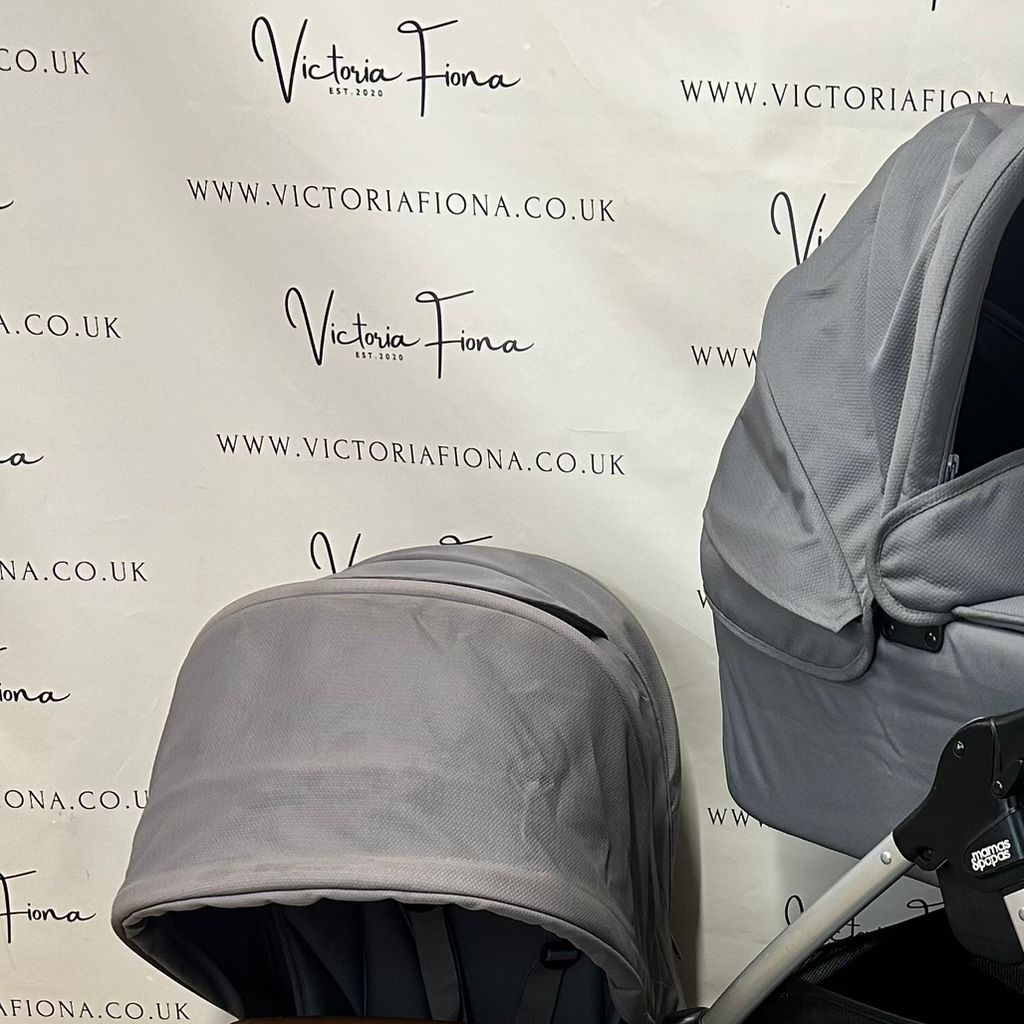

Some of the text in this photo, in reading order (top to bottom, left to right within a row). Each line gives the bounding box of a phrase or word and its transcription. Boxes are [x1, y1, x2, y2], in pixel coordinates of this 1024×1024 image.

[250, 15, 522, 118] Victoria Fiona
[328, 86, 384, 98] EST.2020
[186, 178, 616, 223] WWW.VICTORIAFIONA.CO.UK
[284, 286, 535, 380] Victoria Fiona
[215, 433, 625, 476] WWW.VICTORIAFIONA.CO.UK
[971, 839, 1012, 862] mamas
